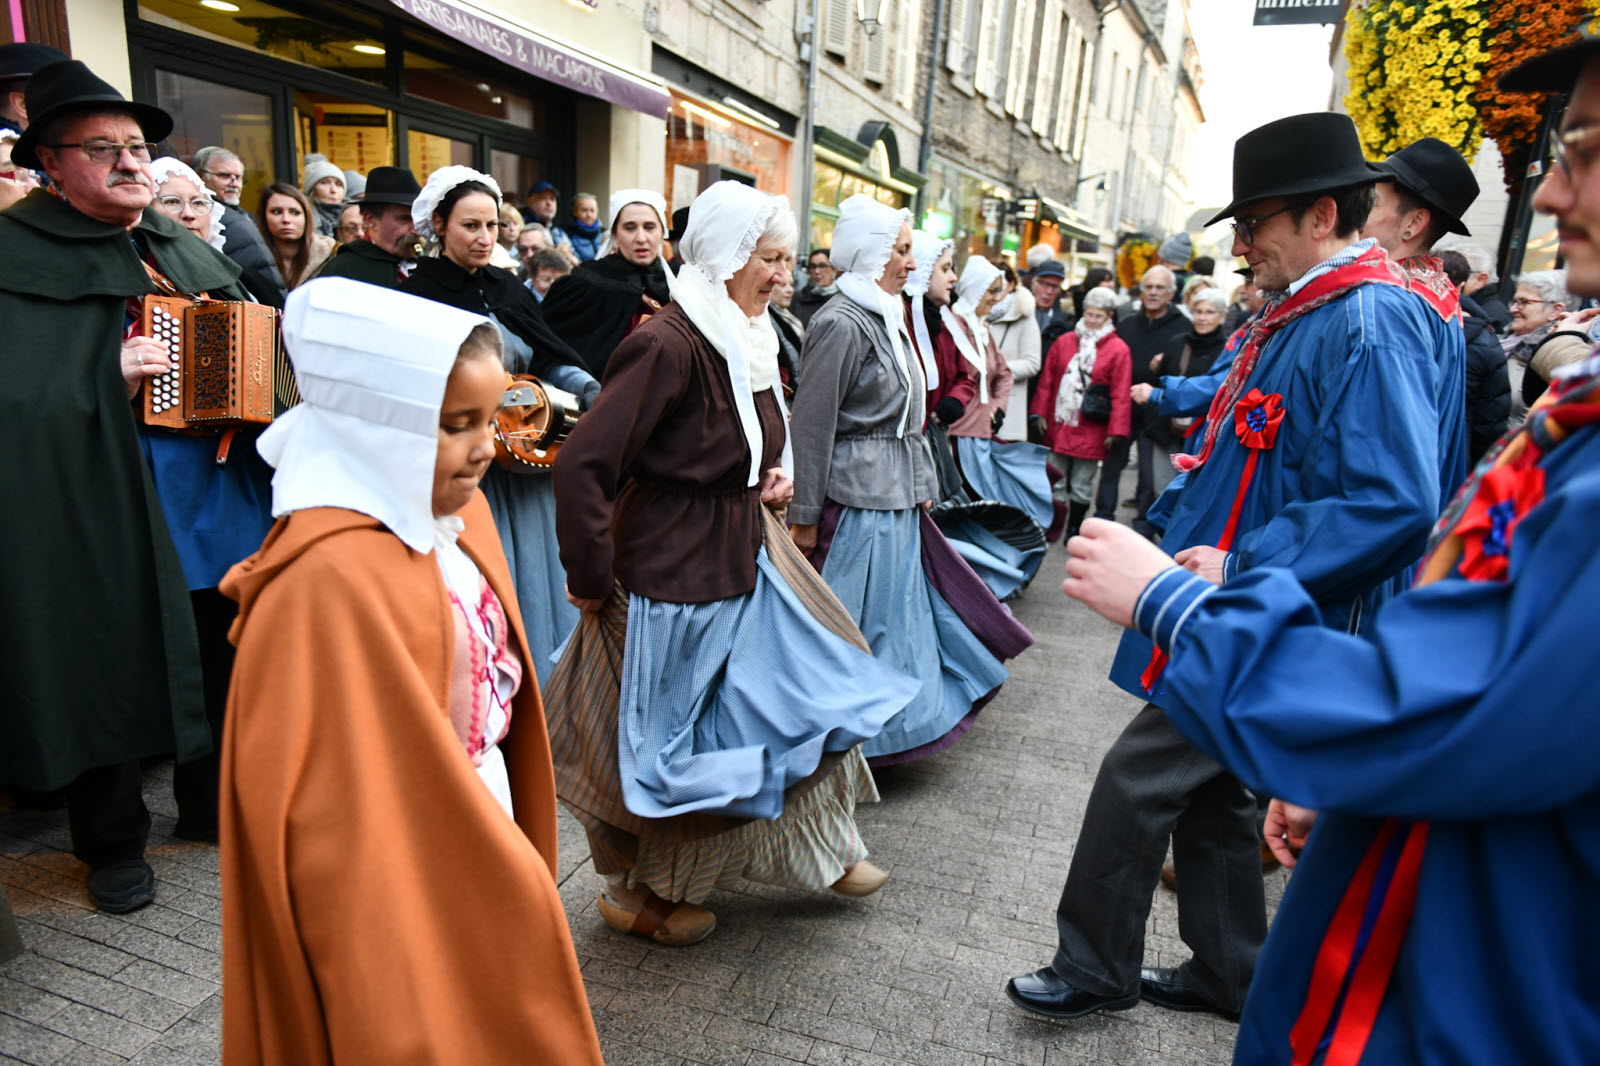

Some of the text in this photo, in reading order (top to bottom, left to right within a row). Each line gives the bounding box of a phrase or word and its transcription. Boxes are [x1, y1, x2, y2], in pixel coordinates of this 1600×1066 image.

[411, 0, 605, 93] ARTISANALES & MACARONS
